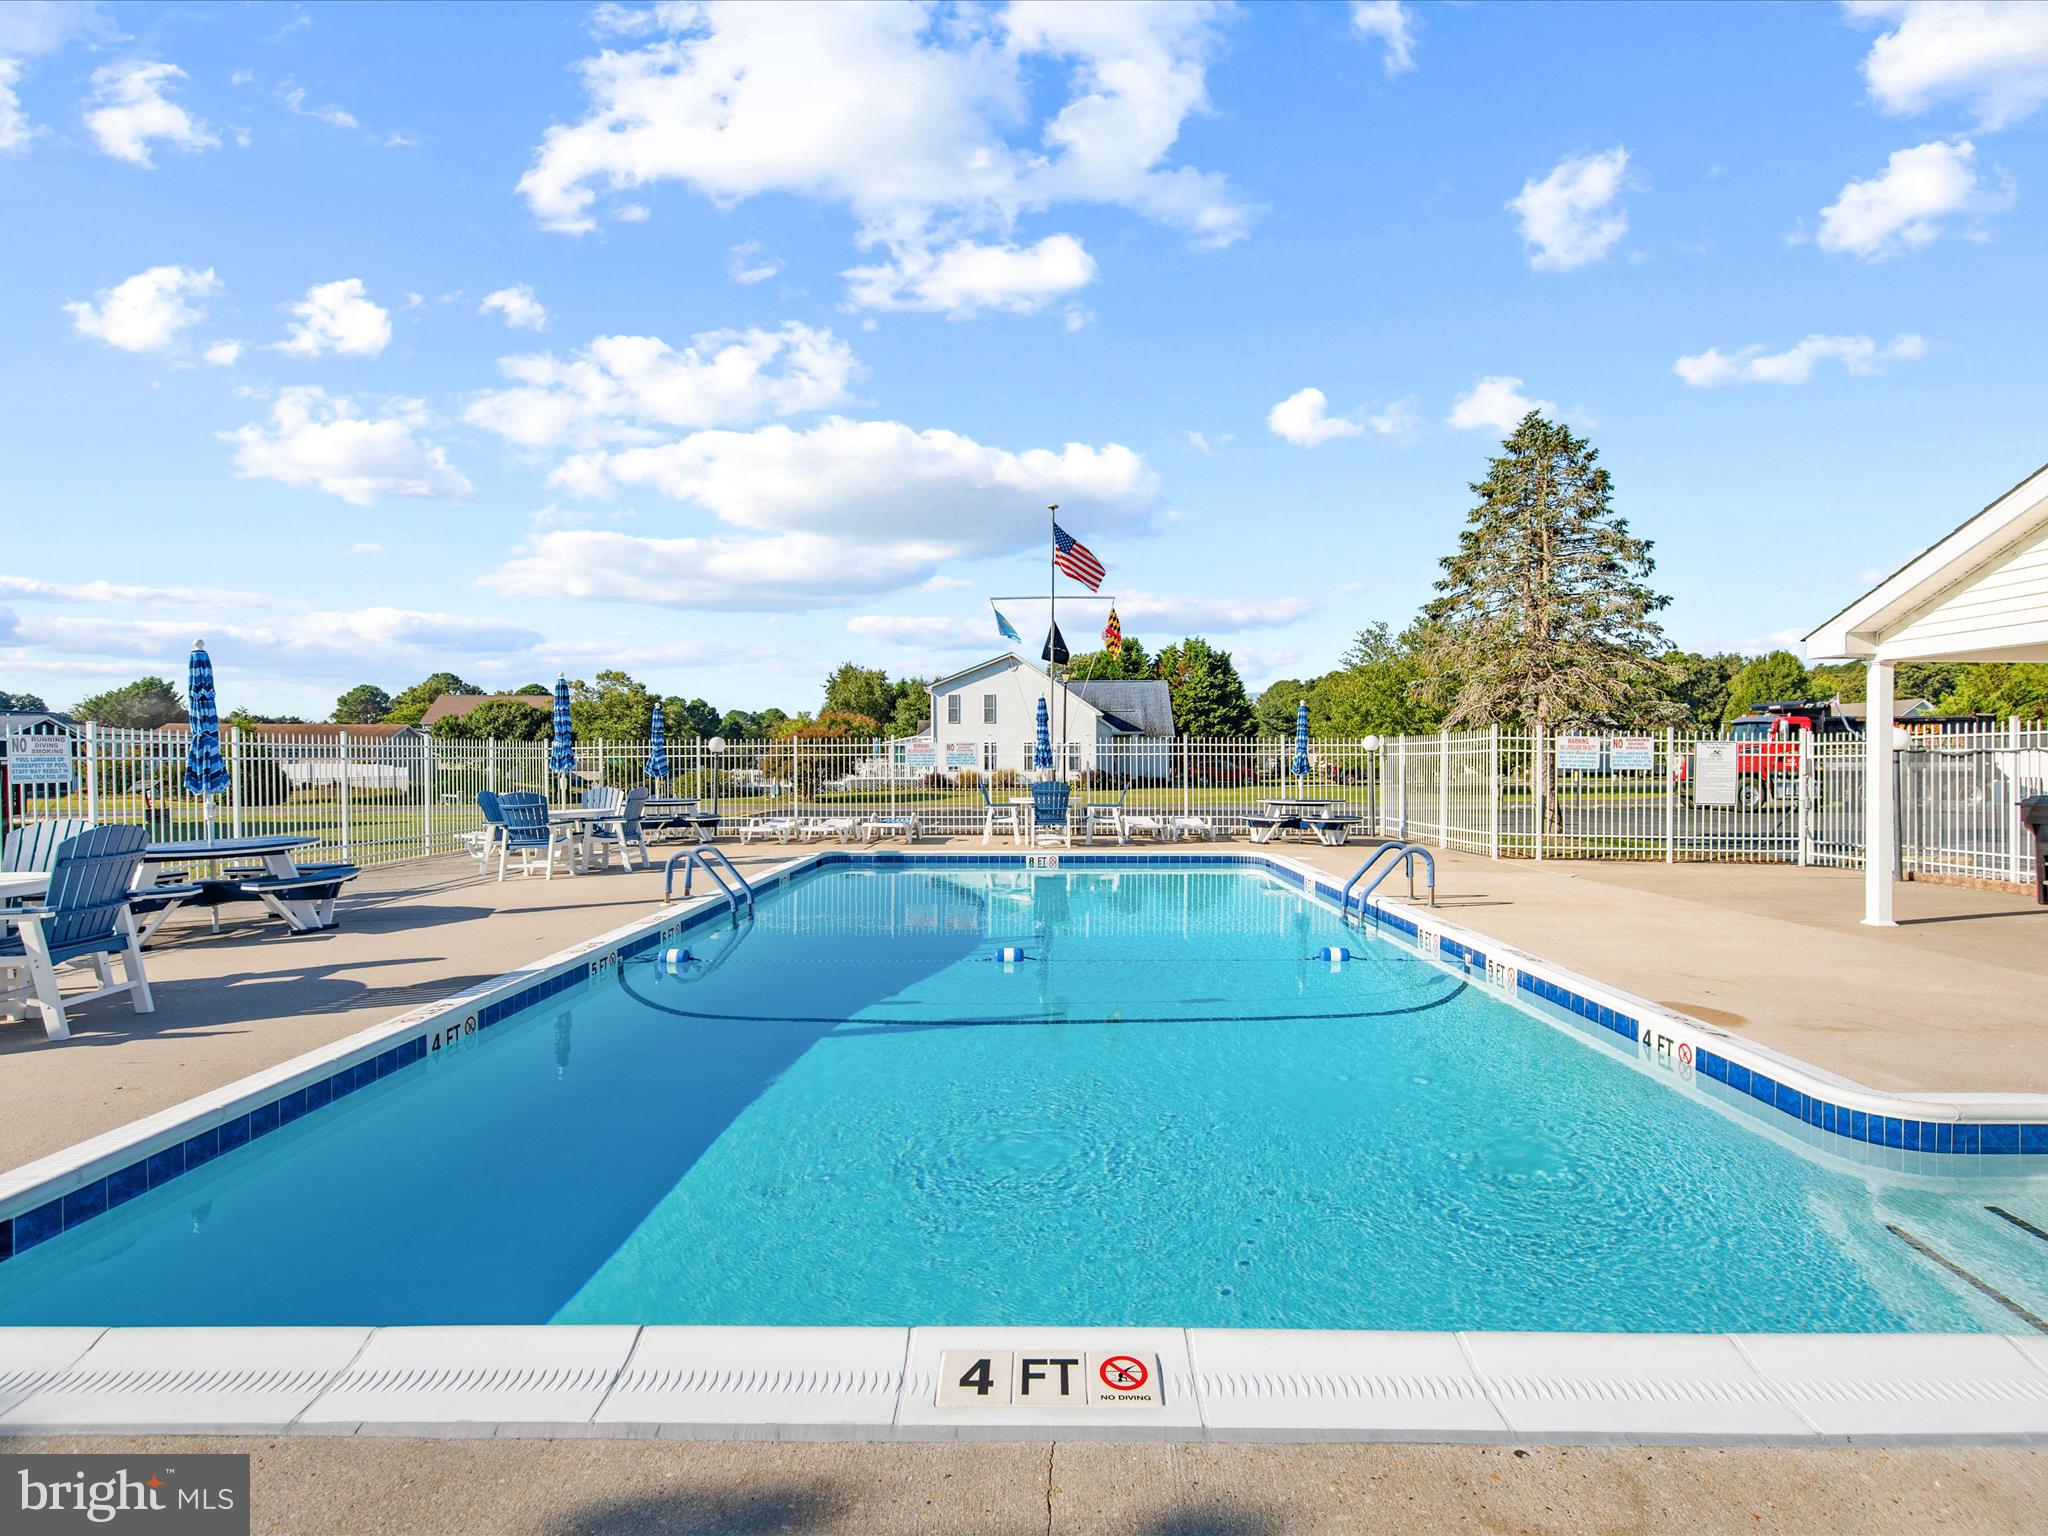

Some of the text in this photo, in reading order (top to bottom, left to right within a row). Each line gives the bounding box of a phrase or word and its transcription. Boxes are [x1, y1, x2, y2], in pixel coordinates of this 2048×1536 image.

[12, 737, 27, 753] NO
[946, 743, 955, 752] NO
[1613, 738, 1623, 749] NO
[591, 956, 608, 976] 5 FT
[1488, 959, 1505, 979] 5 FT
[432, 1023, 461, 1052] 4 FT
[1642, 1029, 1674, 1057] 4 FT
[959, 1358, 1079, 1396] 4 FT
